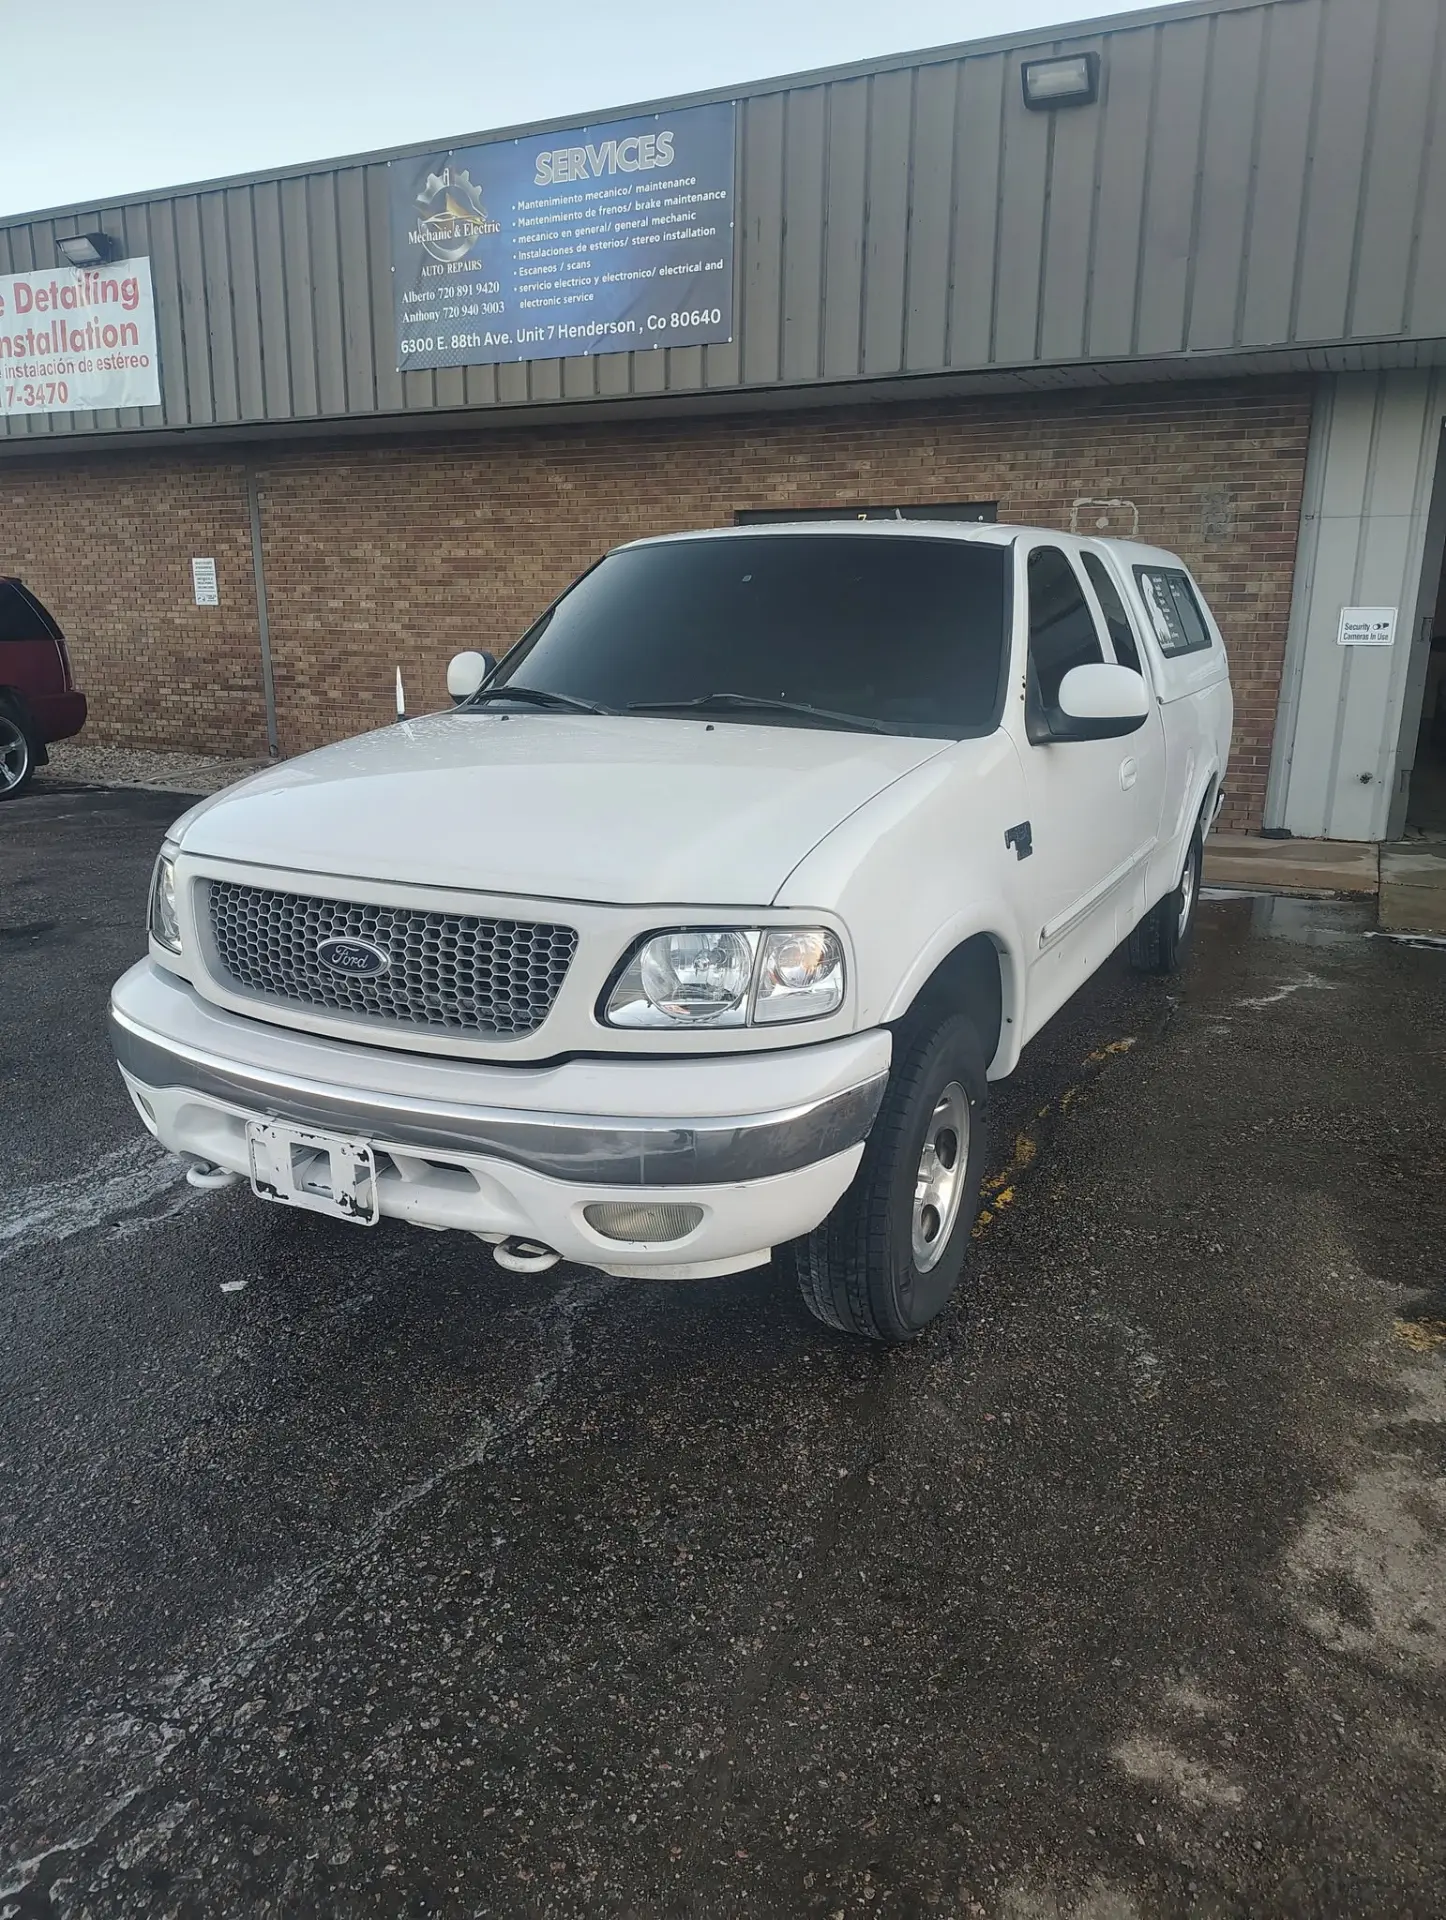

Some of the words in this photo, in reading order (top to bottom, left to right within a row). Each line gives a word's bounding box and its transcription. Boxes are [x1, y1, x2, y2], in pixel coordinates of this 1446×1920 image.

[534, 131, 675, 186] SERVICES
[517, 195, 583, 211] Mantenimiento
[585, 184, 632, 201] mecanico/
[635, 176, 697, 194] maintenance
[518, 211, 583, 228] Mantenimiento
[585, 208, 597, 218] de
[599, 202, 632, 216] frenos/
[635, 198, 661, 211] brake
[664, 190, 727, 206] maintenance
[408, 227, 452, 244] Mechanic
[454, 224, 461, 238] &
[463, 219, 501, 237] Electric
[518, 231, 559, 244] mecanico
[561, 230, 572, 238] en
[574, 222, 612, 238] general/
[614, 216, 649, 232] general
[651, 211, 697, 226] mechanic
[518, 246, 574, 260] Instalaciones
[576, 242, 587, 252] de
[589, 237, 629, 252] esterios/
[631, 234, 660, 246] stereo
[663, 227, 716, 241] installation
[421, 264, 444, 277] AUTO
[447, 259, 482, 274] REPAIRS
[519, 264, 557, 277] Escaneos
[567, 260, 591, 271] scans
[519, 280, 552, 292] servicio
[554, 276, 591, 288] electrico
[593, 276, 599, 285] y
[602, 267, 657, 282] electronico/
[659, 261, 702, 276] electrical
[704, 258, 723, 271] and
[13, 272, 140, 314] Detailing
[401, 291, 436, 304] Alberto
[437, 286, 455, 299] 720
[456, 284, 473, 297] 891
[476, 280, 500, 295] 9420
[520, 296, 561, 309] electronic
[563, 292, 594, 303] service
[402, 310, 440, 323] Anthony
[443, 306, 460, 319] 720
[461, 304, 479, 317] 940
[481, 301, 505, 315] 3003
[401, 338, 433, 354] 6300
[437, 336, 448, 350] E.
[451, 332, 481, 349] 88th
[483, 331, 513, 346] Ave.
[516, 326, 544, 343] Unit
[547, 325, 555, 340] 7
[647, 314, 666, 330] Co
[670, 308, 721, 328] 80640
[4, 357, 75, 379] instalación
[78, 356, 93, 373] de
[96, 351, 150, 371] estéreo
[0, 381, 69, 408] 7-3470
[1343, 632, 1369, 640] Cameras
[1370, 632, 1376, 640] In
[1344, 622, 1371, 632] Security
[331, 945, 369, 969] Ford
